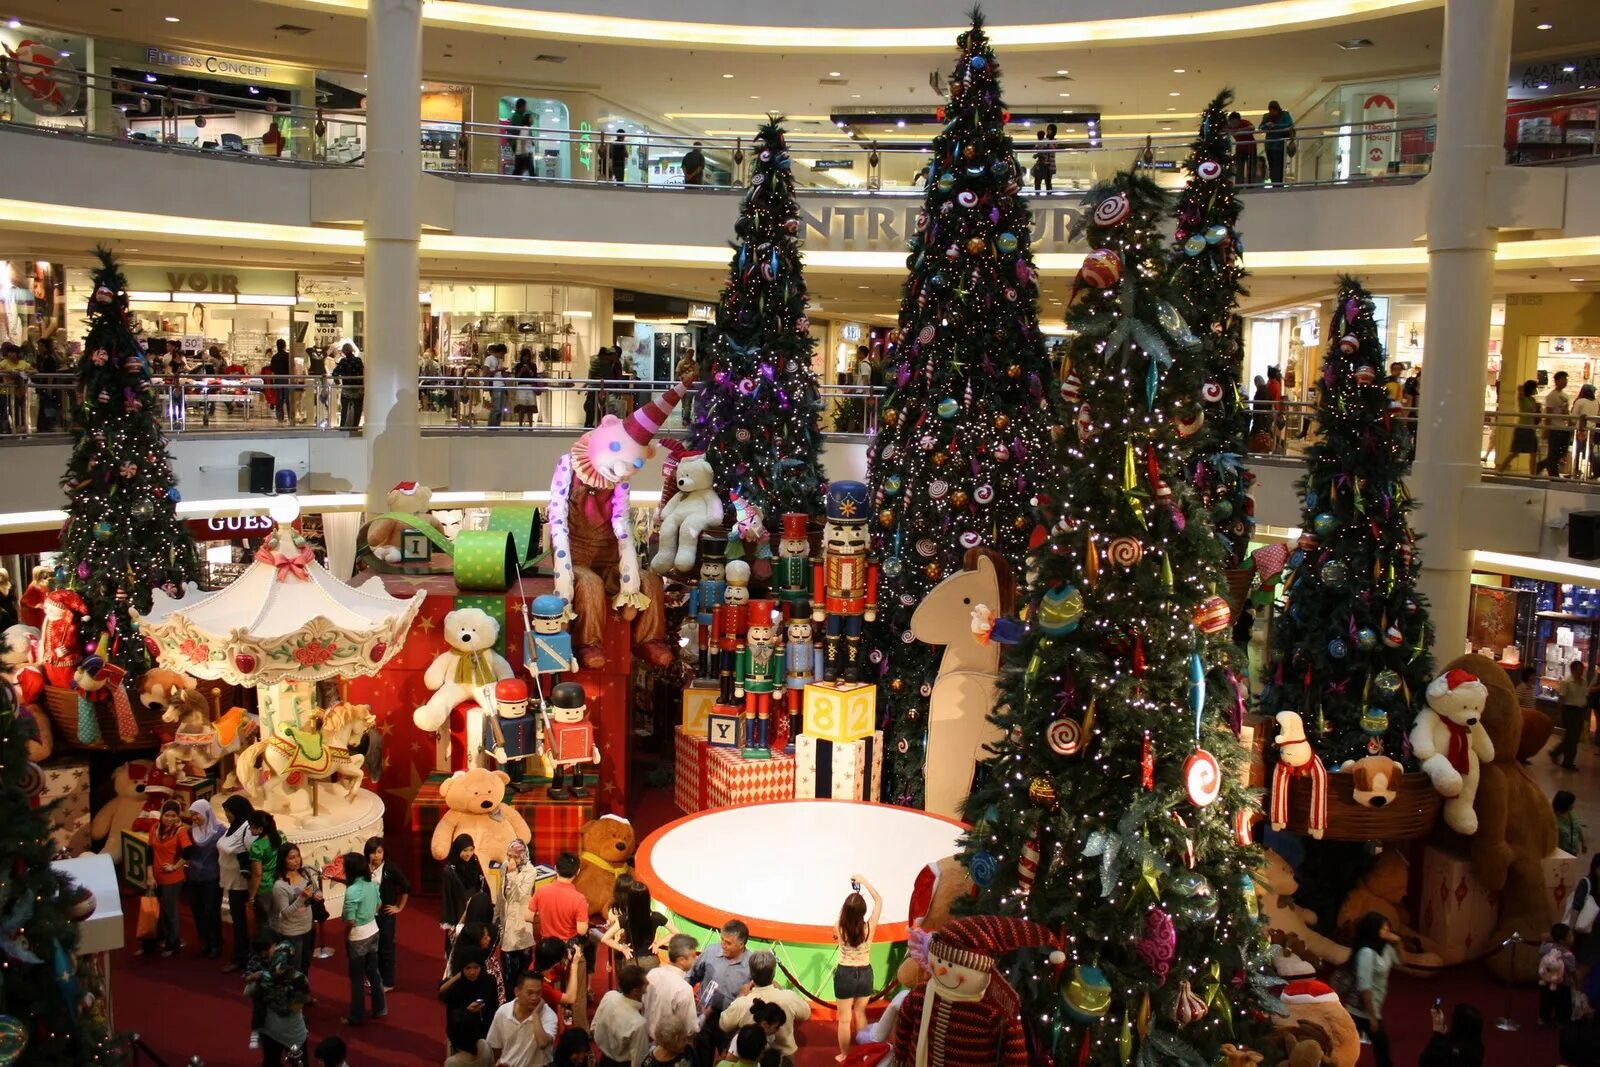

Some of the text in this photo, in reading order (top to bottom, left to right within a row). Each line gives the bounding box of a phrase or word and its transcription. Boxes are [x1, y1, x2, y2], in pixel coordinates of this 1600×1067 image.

[205, 57, 268, 77] CONCEPT
[166, 271, 240, 294] VOIR
[208, 515, 272, 531] GUES
[814, 697, 833, 730] 8
[852, 698, 868, 731] 2
[716, 723, 730, 738] Y
[126, 842, 146, 880] B
